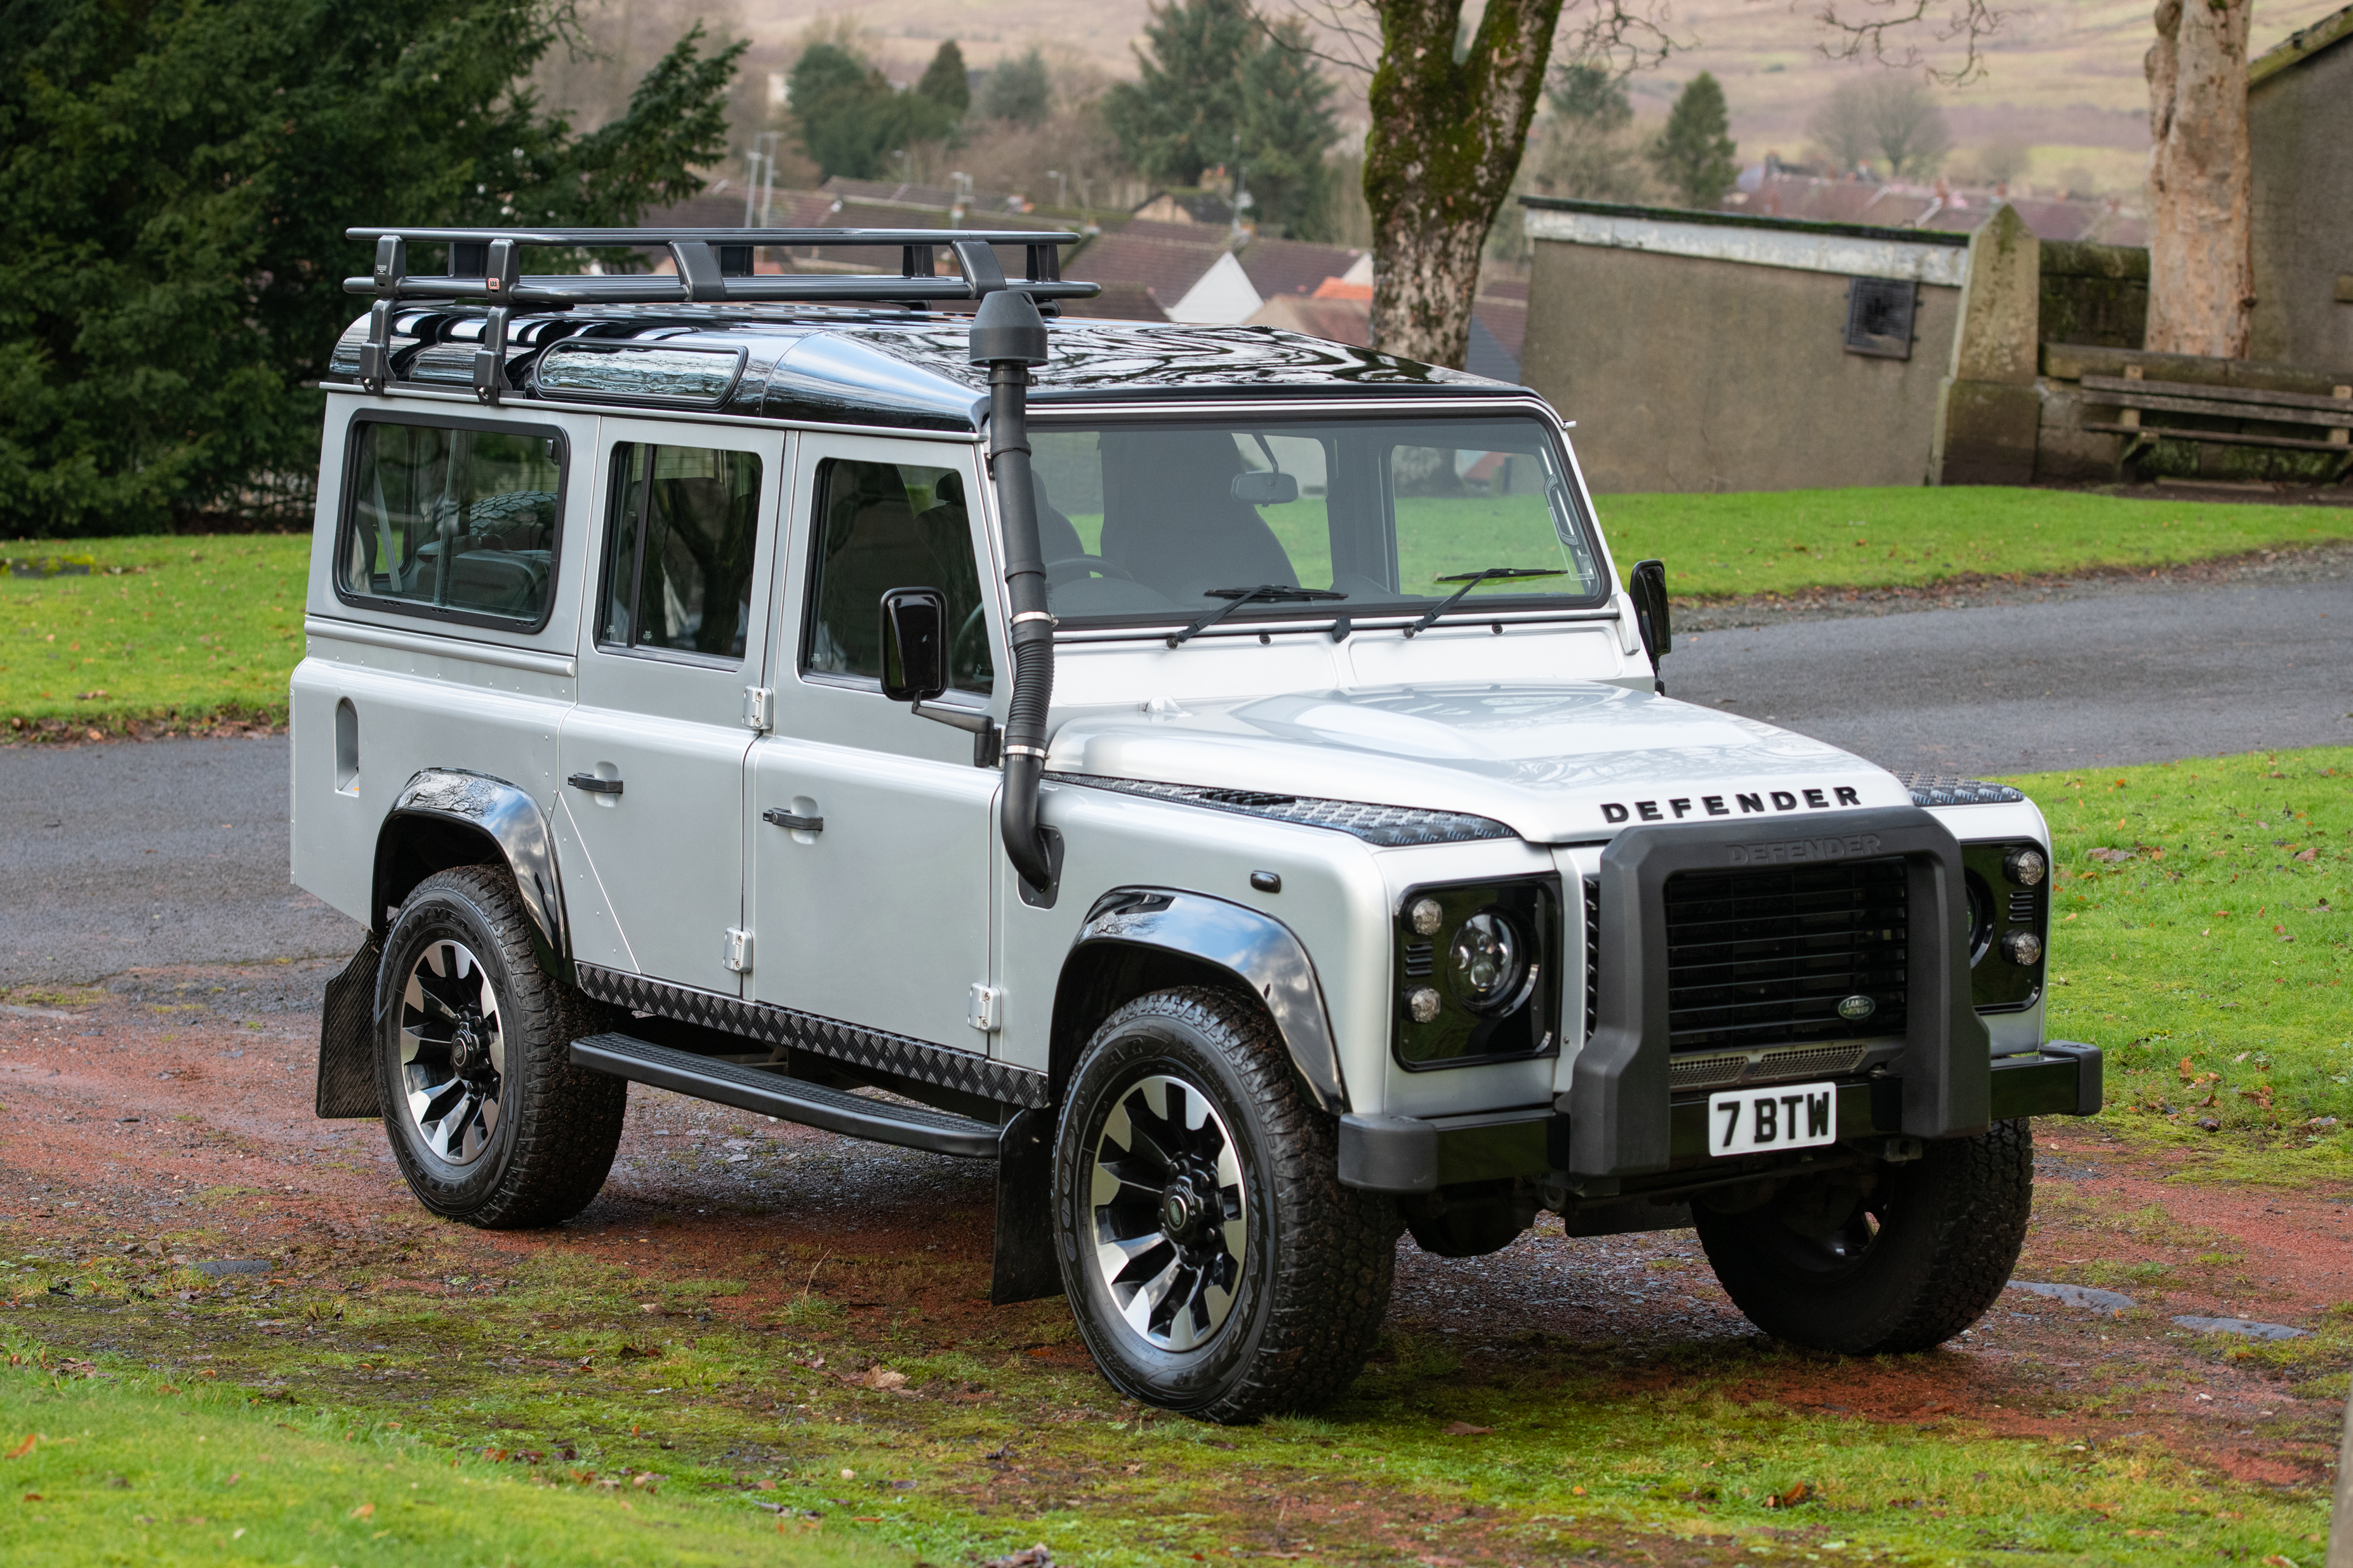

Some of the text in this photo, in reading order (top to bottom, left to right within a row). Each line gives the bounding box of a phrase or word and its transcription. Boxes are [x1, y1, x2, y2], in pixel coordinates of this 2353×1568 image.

[1600, 786, 1860, 823] DEFENDER
[1726, 833, 1881, 864] DEFENDER
[1846, 999, 1865, 1008] LAND
[1847, 1006, 1870, 1015] ROVER
[1718, 1091, 1829, 1147] 7 BTW
